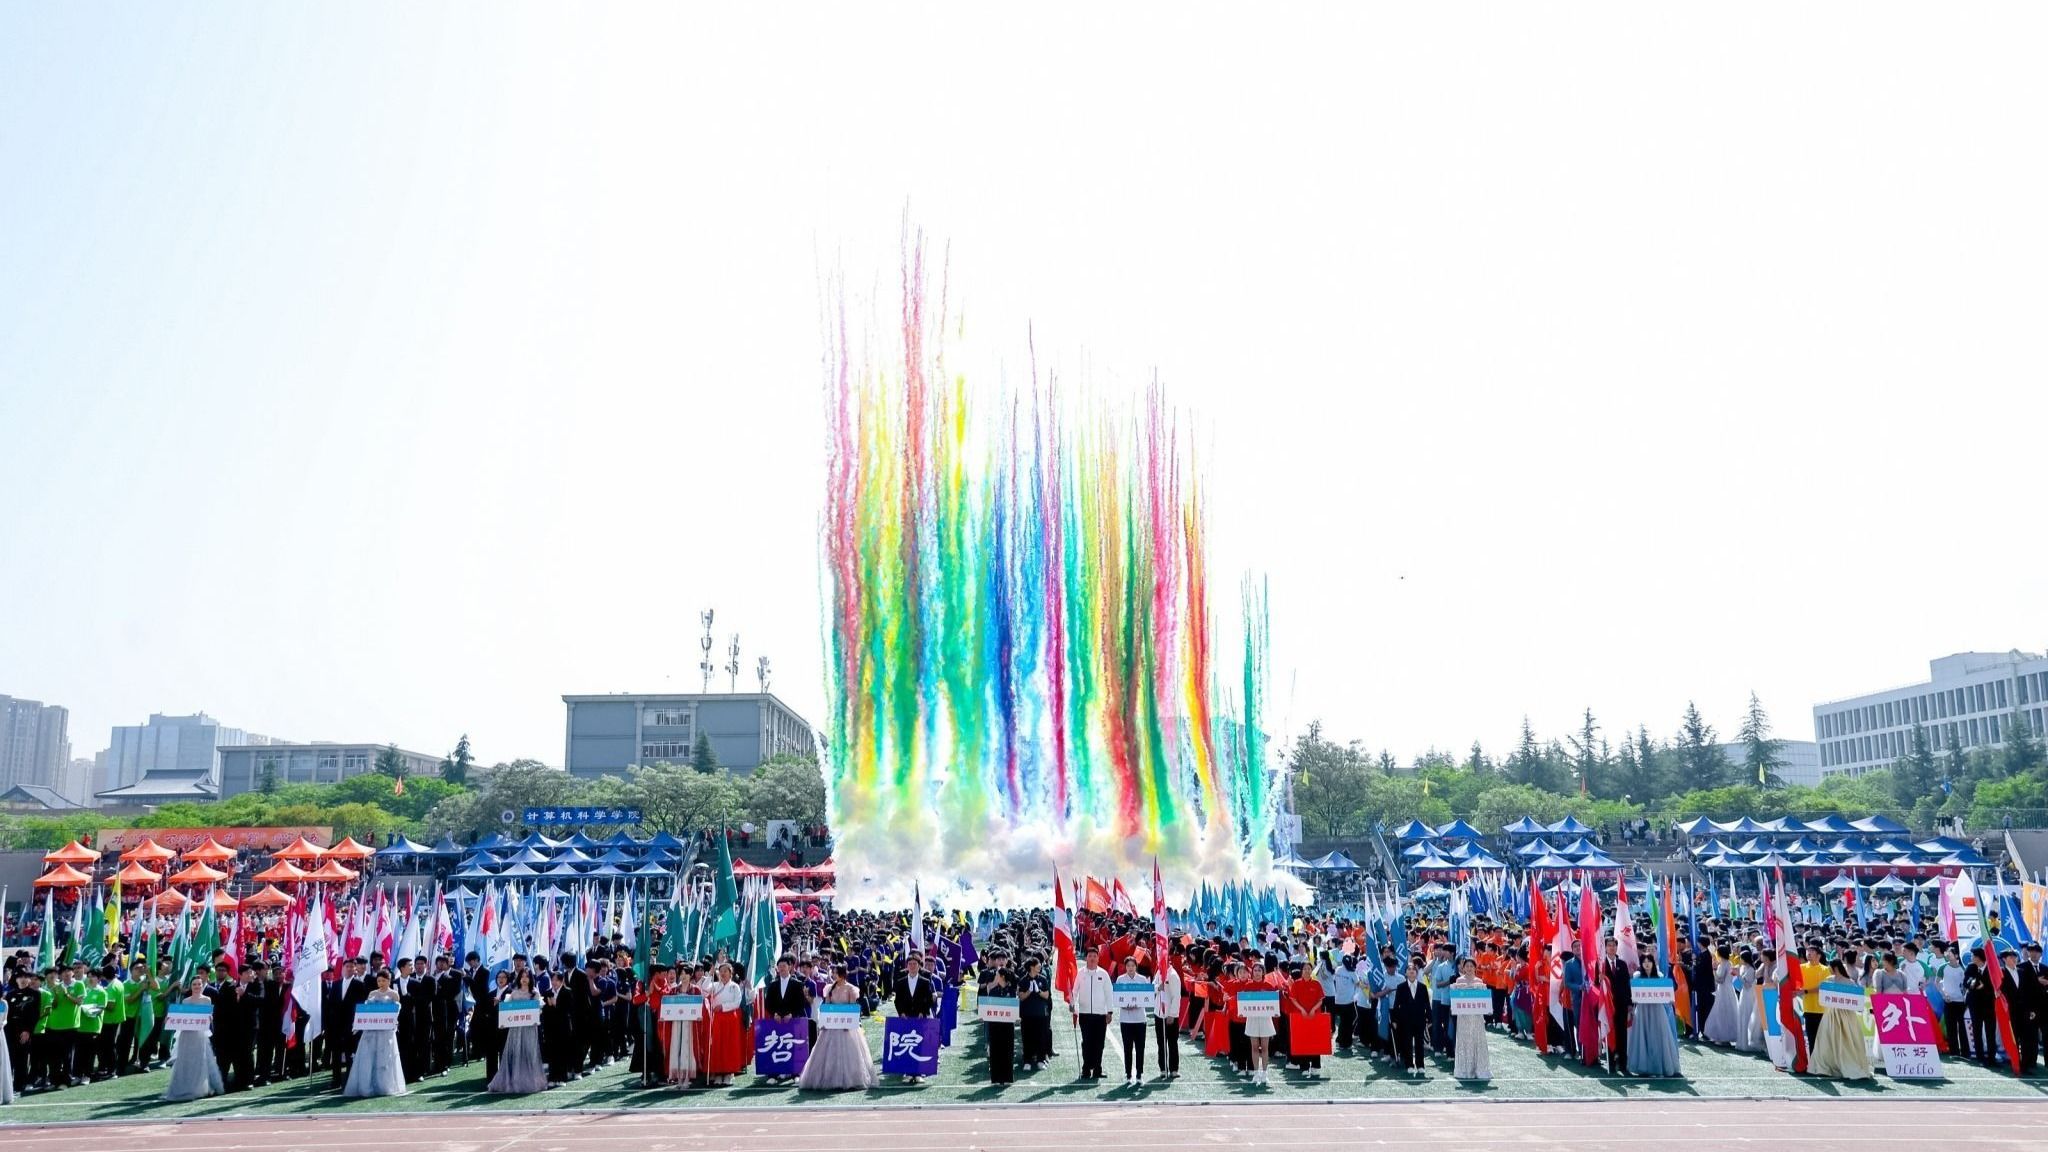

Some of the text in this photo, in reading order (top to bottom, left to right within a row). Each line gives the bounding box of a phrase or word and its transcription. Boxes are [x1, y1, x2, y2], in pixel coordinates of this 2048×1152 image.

[527, 810, 641, 821] 计算机科学学院
[1824, 995, 1858, 1006] 外国语学院
[507, 1014, 532, 1022] 心理学院
[1881, 996, 1928, 1042] 外
[757, 1029, 806, 1064] 哲
[887, 1029, 933, 1062] 院
[1891, 1046, 1928, 1058] 你好
[1895, 1063, 1934, 1075] Hello
